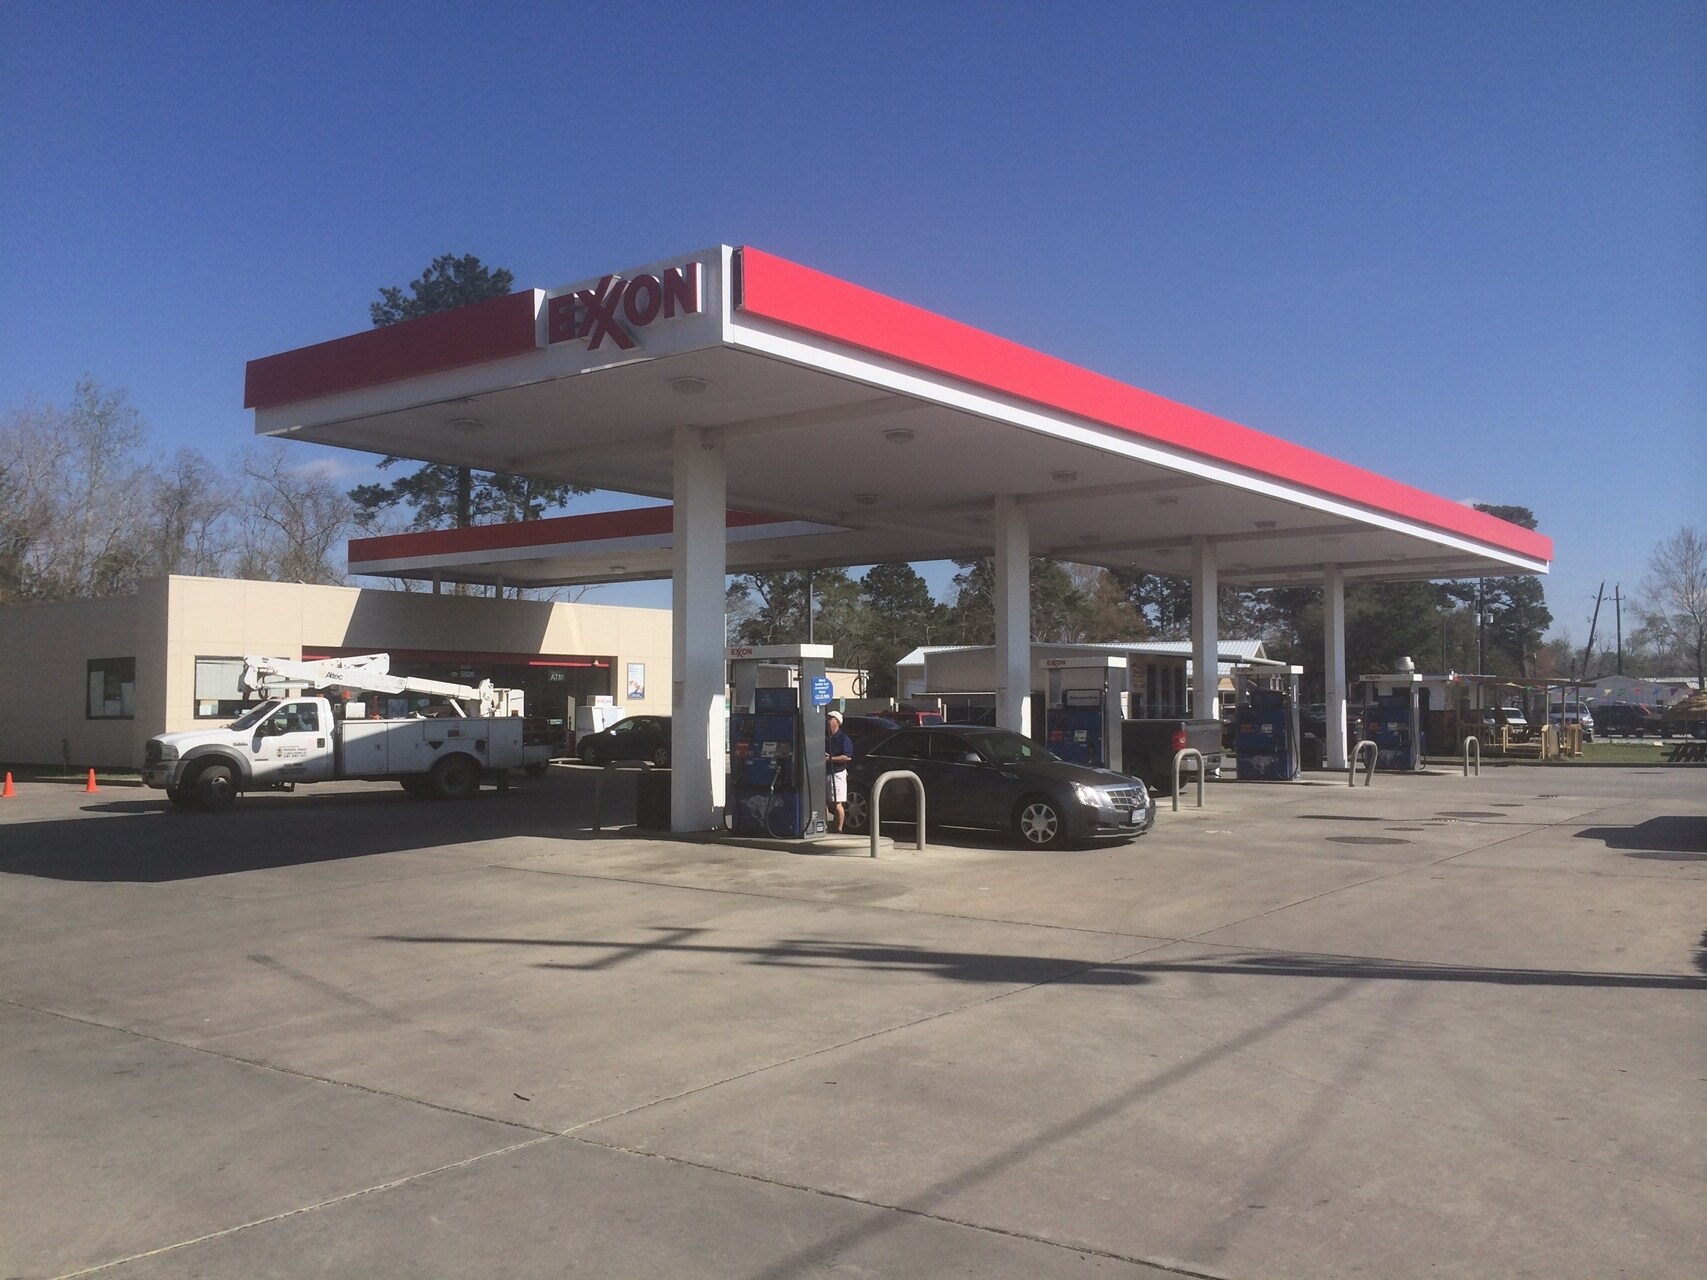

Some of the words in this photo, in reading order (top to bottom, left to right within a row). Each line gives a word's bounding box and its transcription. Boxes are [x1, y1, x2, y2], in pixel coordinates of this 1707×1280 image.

[548, 262, 702, 351] EXXON
[731, 648, 753, 658] EXXON
[1046, 659, 1066, 668] EXXON
[325, 671, 343, 681] Altec
